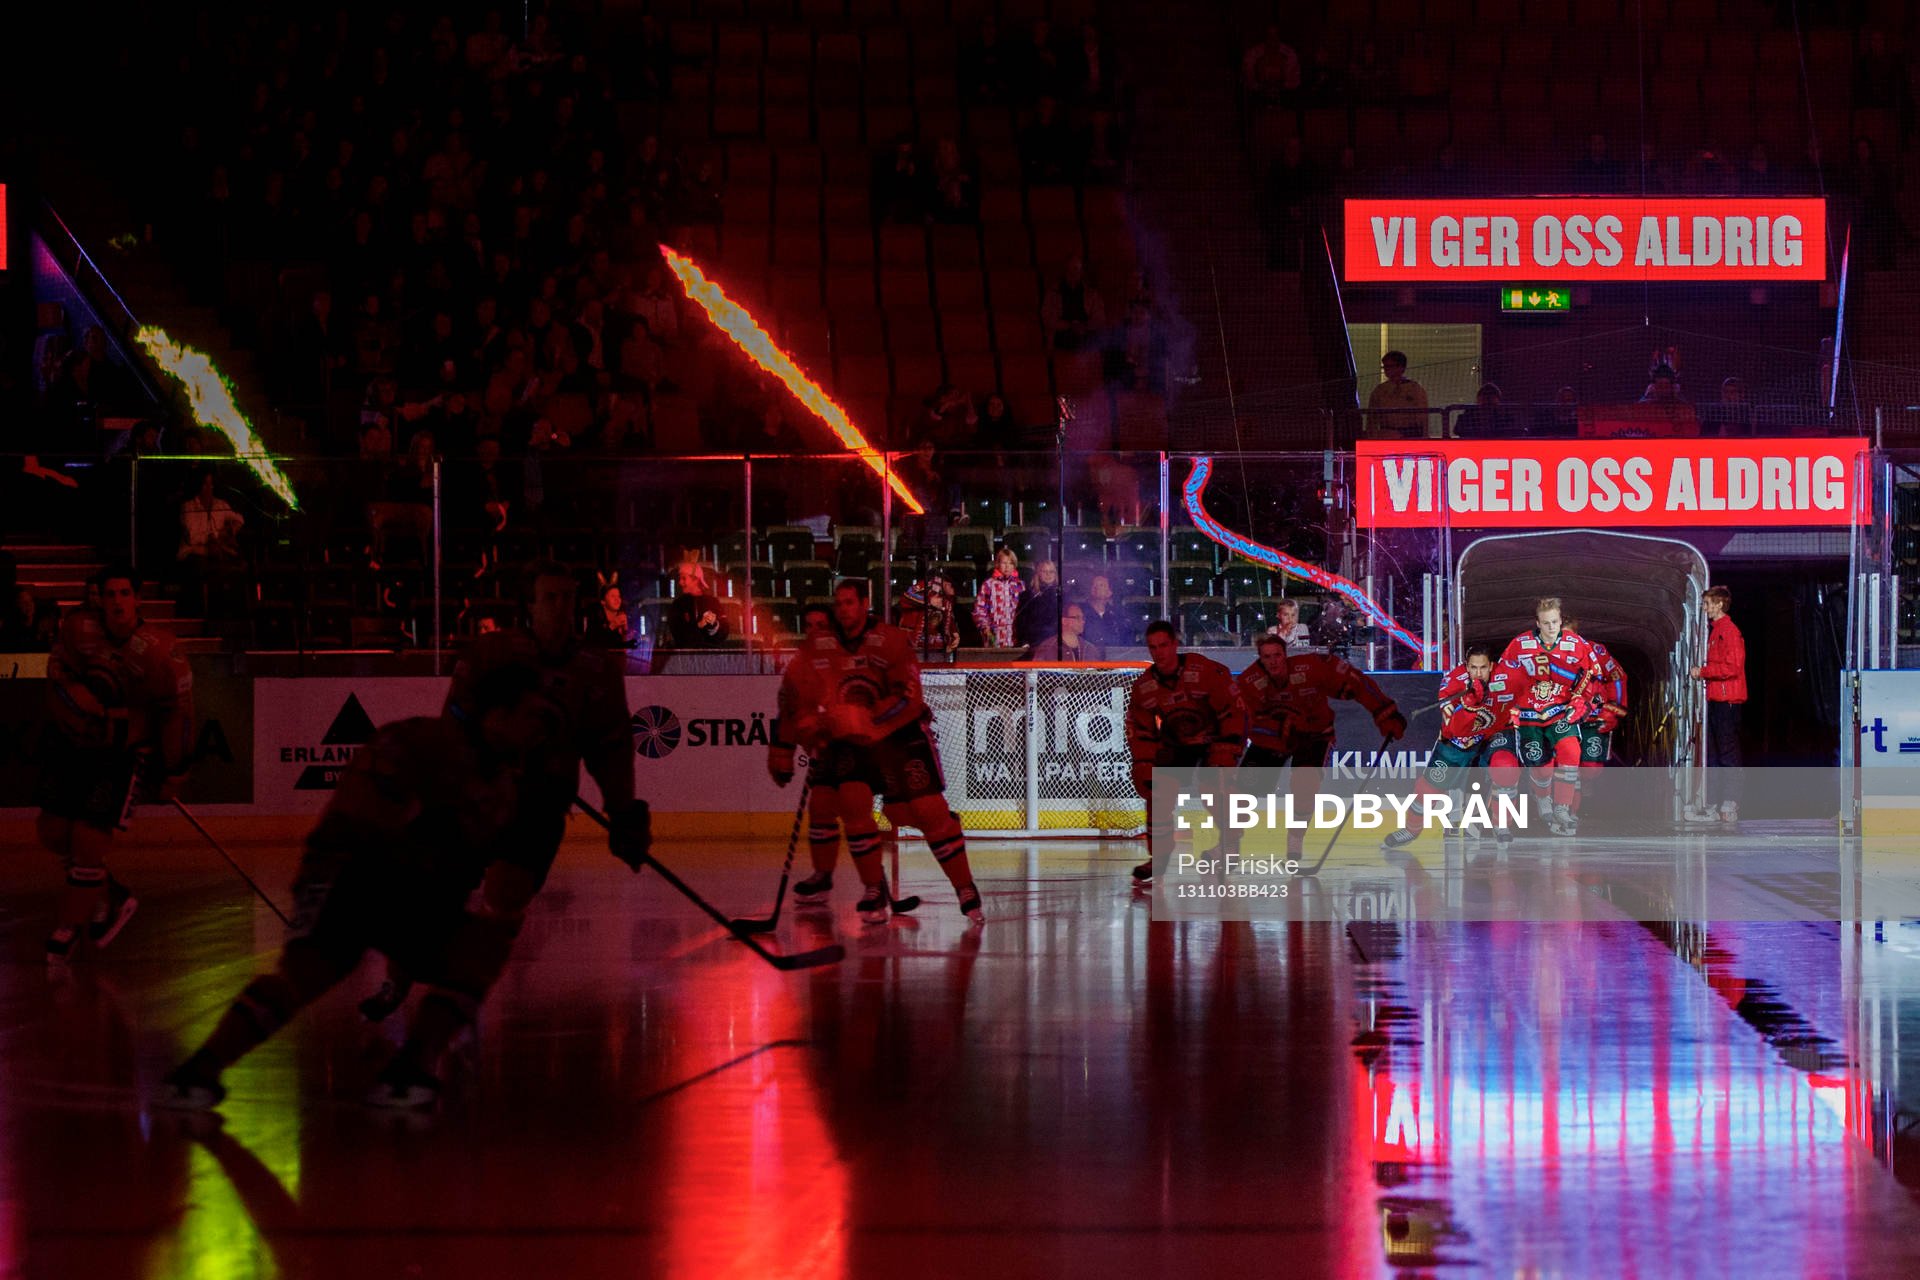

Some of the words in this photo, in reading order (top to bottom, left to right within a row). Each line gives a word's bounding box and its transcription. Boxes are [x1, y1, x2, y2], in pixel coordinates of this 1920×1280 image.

[1371, 216, 1417, 267] VI
[1430, 215, 1521, 267] GER
[1532, 215, 1623, 267] OSS
[1635, 215, 1803, 267] ALDRIG
[1382, 458, 1433, 512] VI
[1447, 457, 1544, 513] GER
[1556, 456, 1653, 513] OSS
[1665, 456, 1846, 512] ALDRIG
